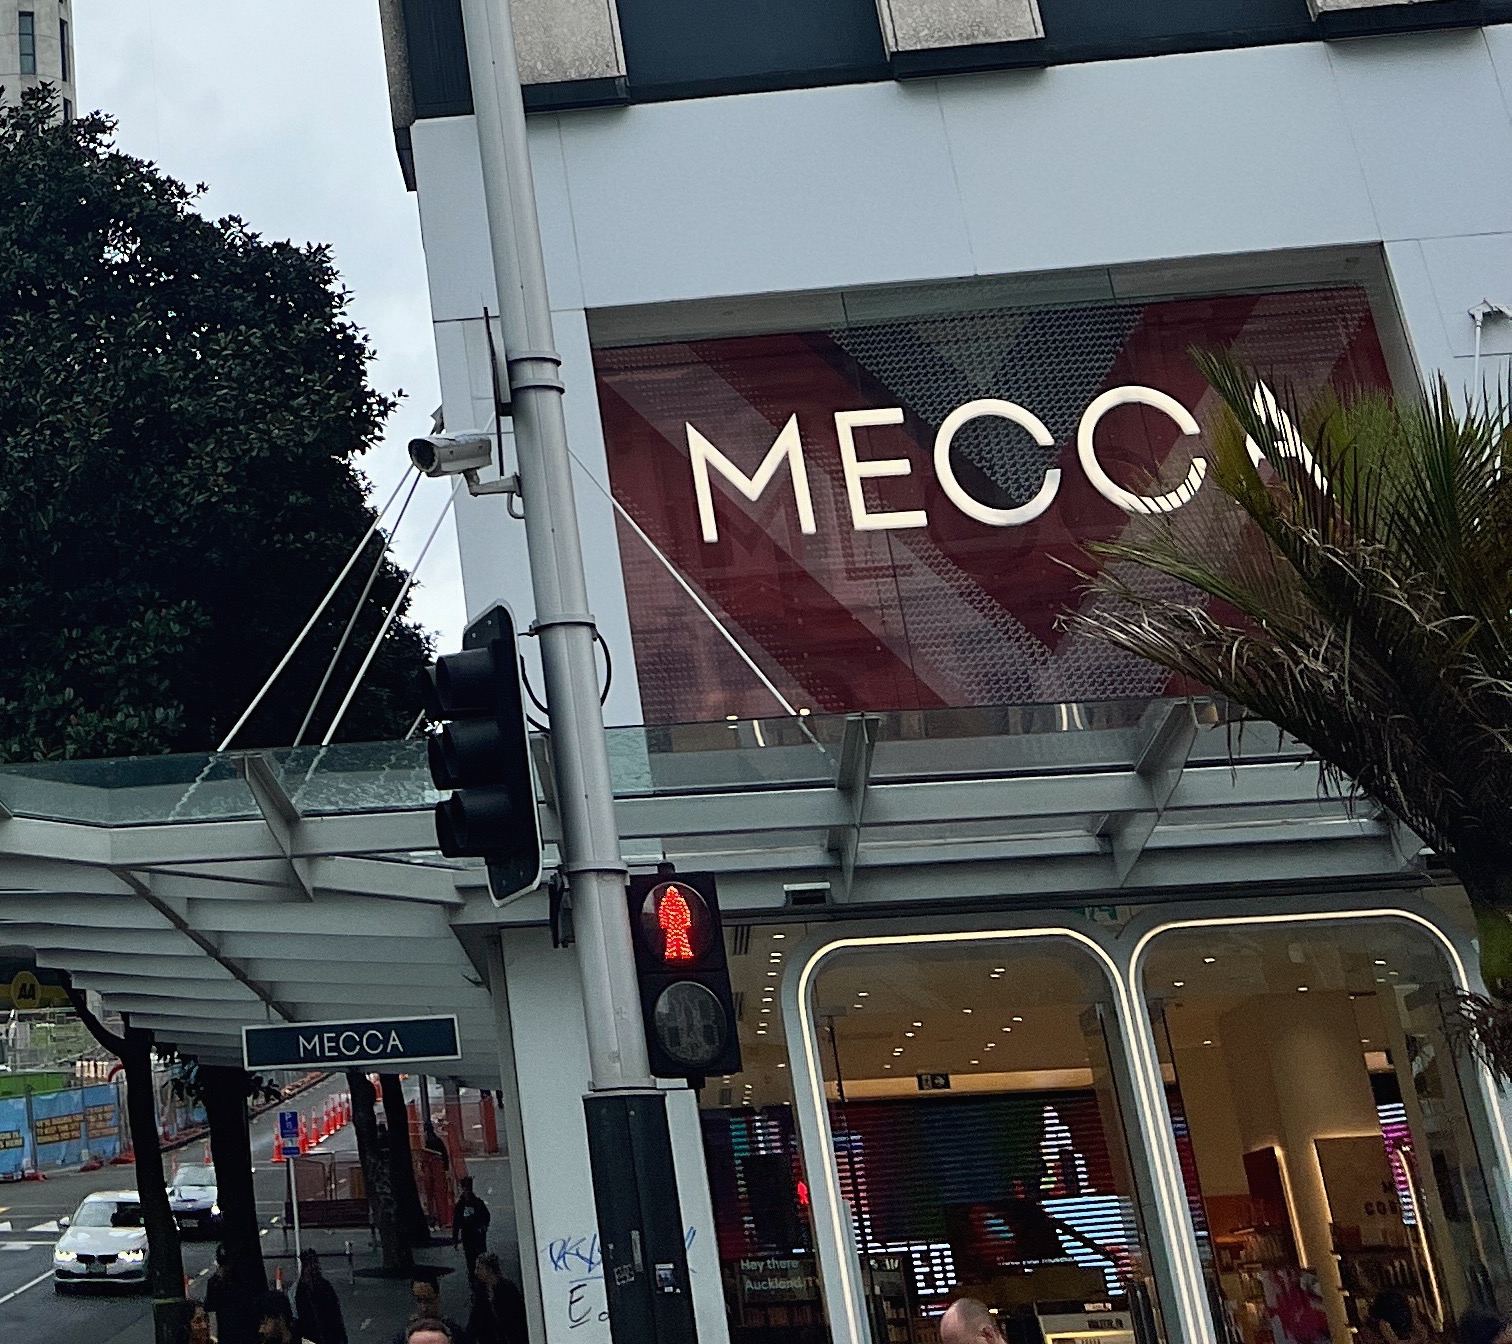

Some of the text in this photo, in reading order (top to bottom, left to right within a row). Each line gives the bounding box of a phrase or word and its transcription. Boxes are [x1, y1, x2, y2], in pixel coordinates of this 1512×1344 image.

[17, 982, 36, 1000] AA
[298, 1029, 404, 1058] MECCA
[741, 1257, 799, 1273] Hey there
